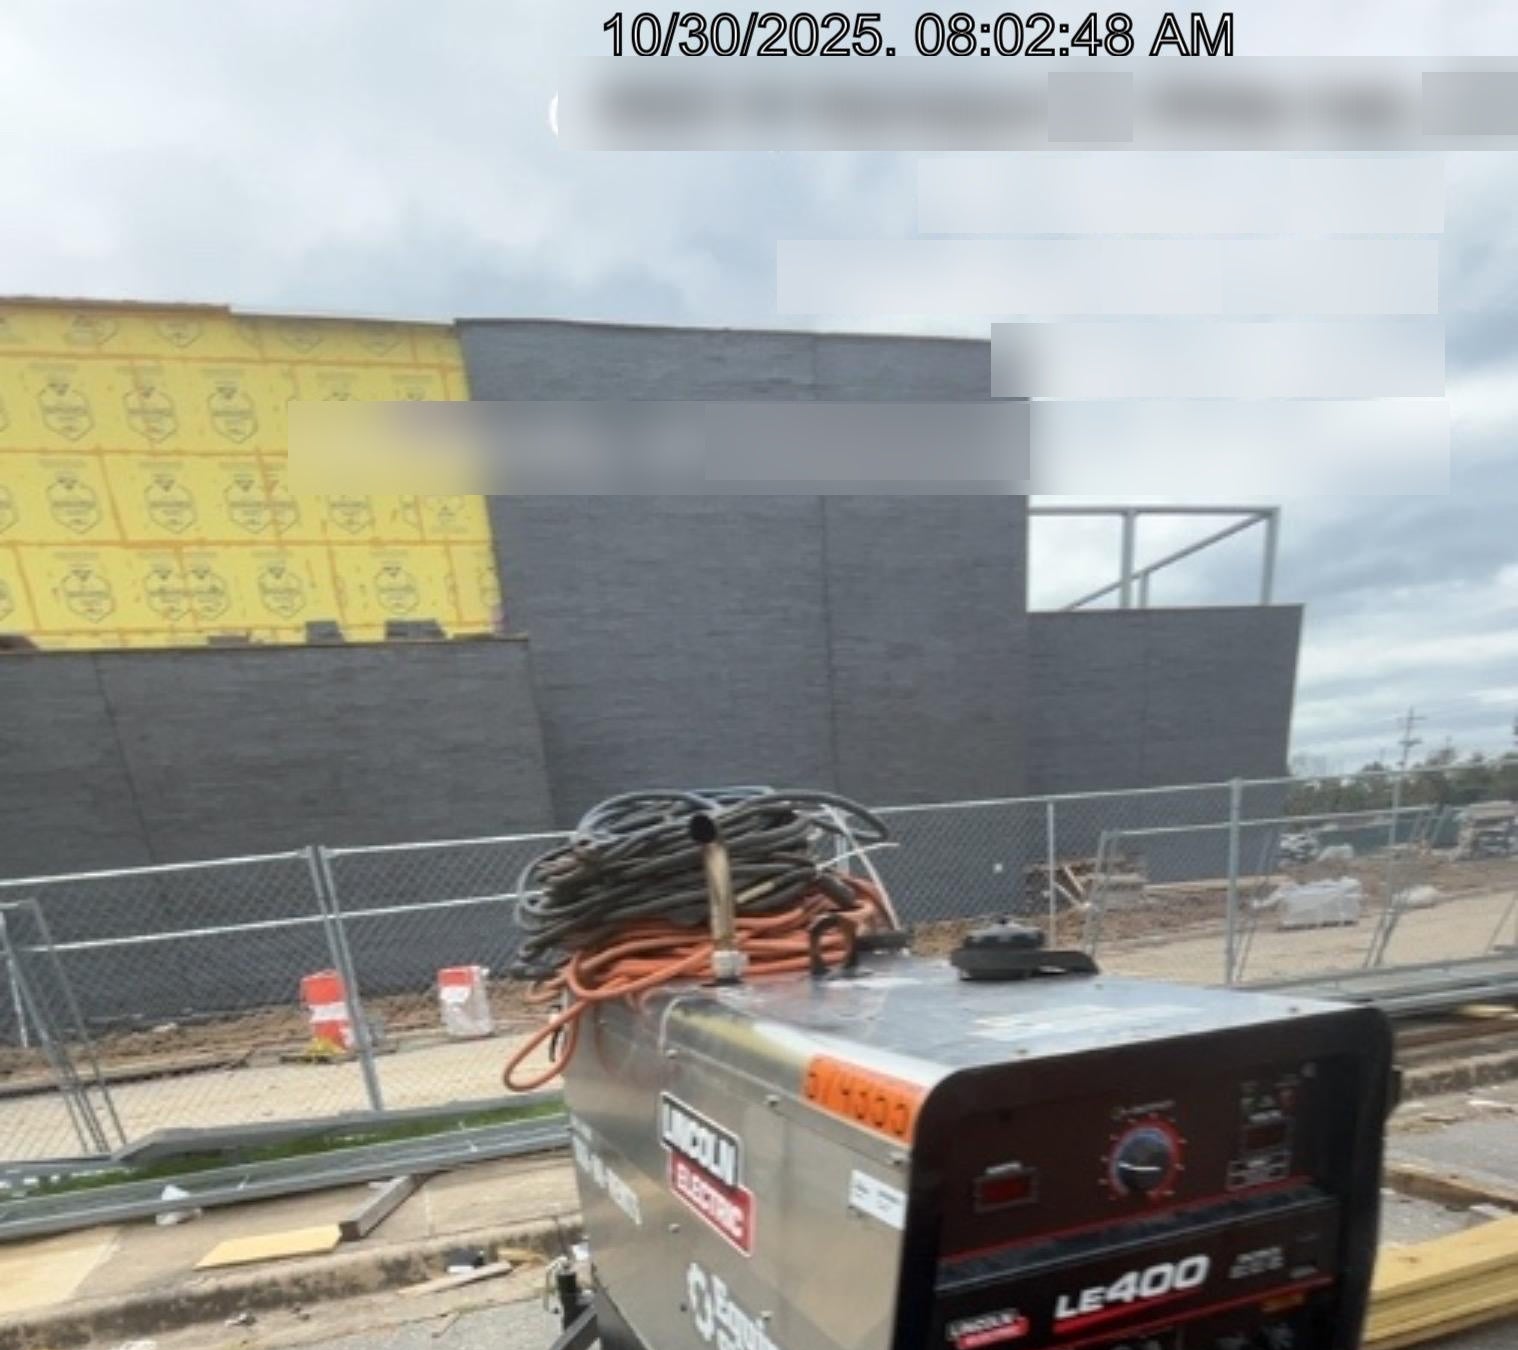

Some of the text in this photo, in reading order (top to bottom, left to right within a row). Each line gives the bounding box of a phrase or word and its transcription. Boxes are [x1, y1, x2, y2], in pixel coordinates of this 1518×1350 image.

[662, 1103, 738, 1187] LINCOLN
[676, 1161, 744, 1238] ELECTRIC
[1054, 1255, 1211, 1320] LE400
